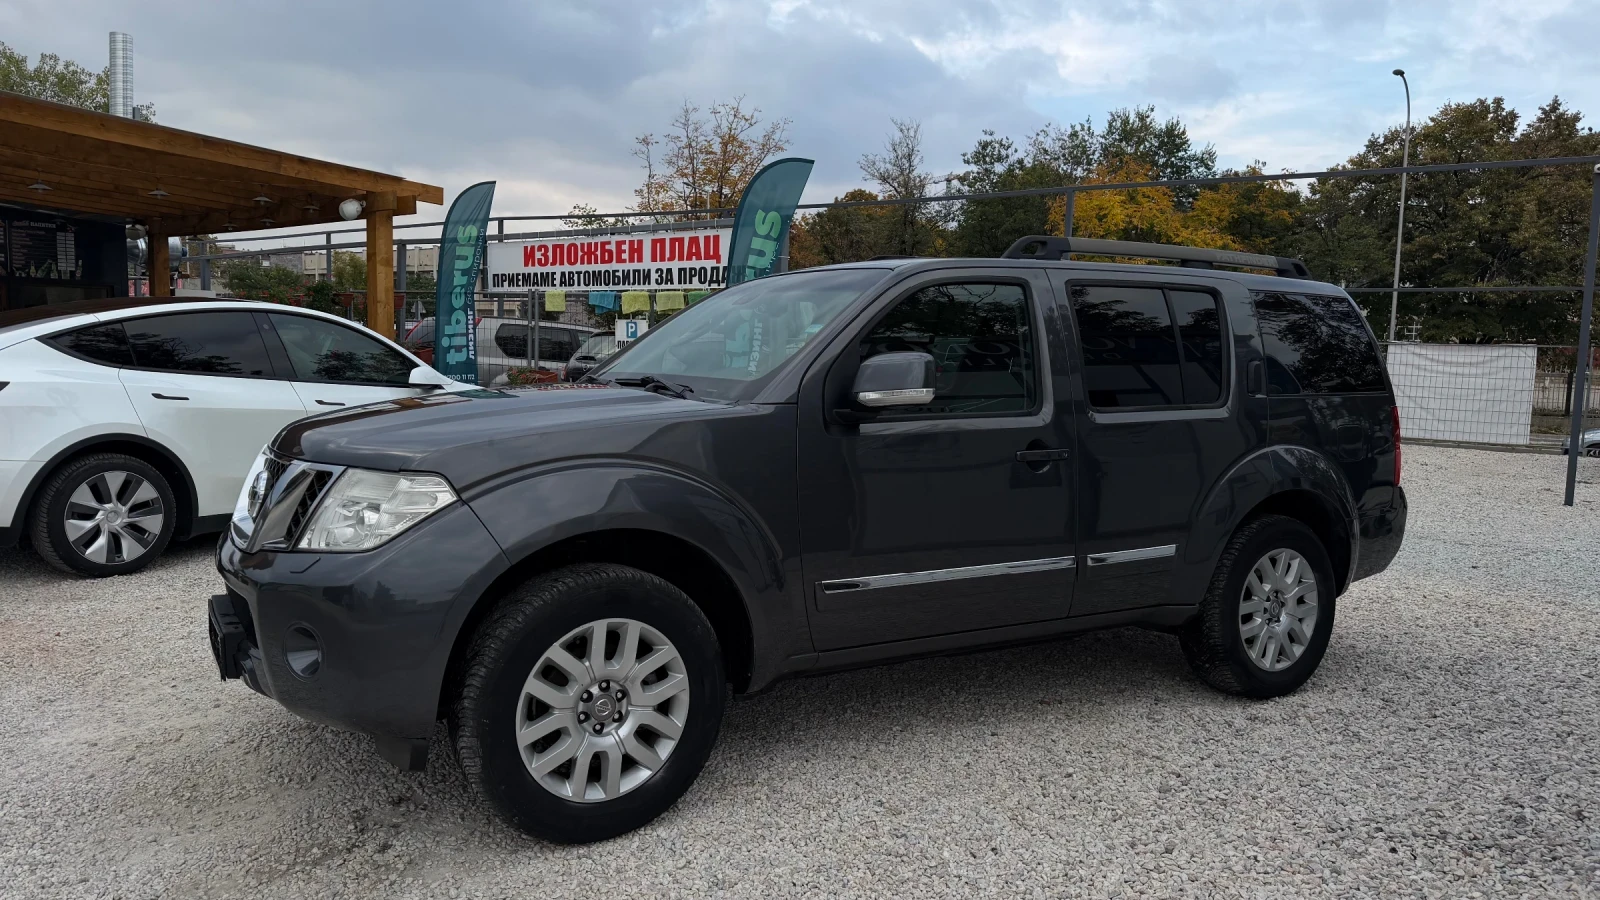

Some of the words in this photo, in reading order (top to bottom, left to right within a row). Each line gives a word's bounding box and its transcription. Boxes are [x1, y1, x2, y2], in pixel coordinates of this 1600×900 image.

[523, 239, 644, 267] ИЗЛОЖБЕН
[650, 234, 721, 264] ПЛАЦ
[492, 272, 556, 288] ПРИЕМАМЕ
[559, 268, 651, 287] АВТОМОБИЛИ
[655, 267, 674, 286] ЗА
[441, 225, 477, 364] tiberus
